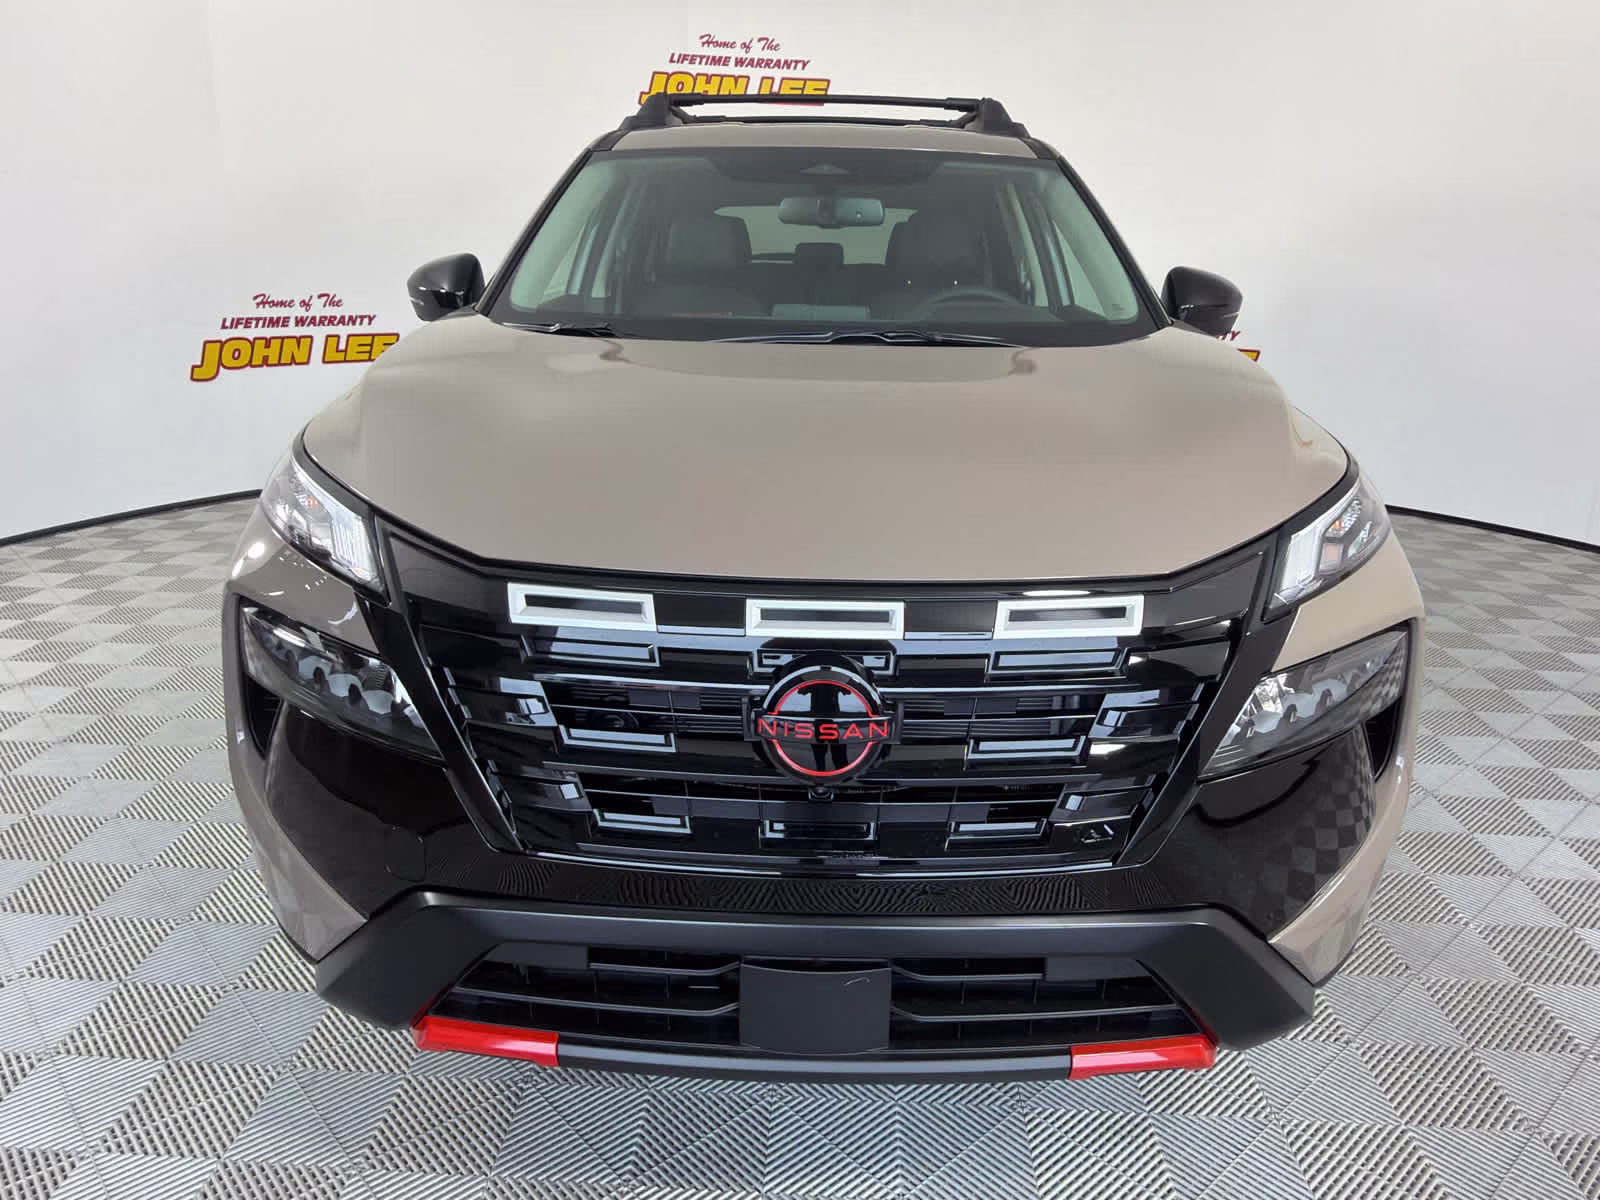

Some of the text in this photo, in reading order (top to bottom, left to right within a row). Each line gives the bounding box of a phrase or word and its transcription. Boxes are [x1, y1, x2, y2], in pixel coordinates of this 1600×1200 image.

[700, 33, 780, 53] Home of The
[669, 53, 810, 70] LIFETIME WARRANTY
[253, 293, 343, 312] Home of The
[220, 315, 376, 330] LIFETIME WARRANTY
[190, 335, 313, 381] JOHN
[757, 718, 889, 740] NISSAN
